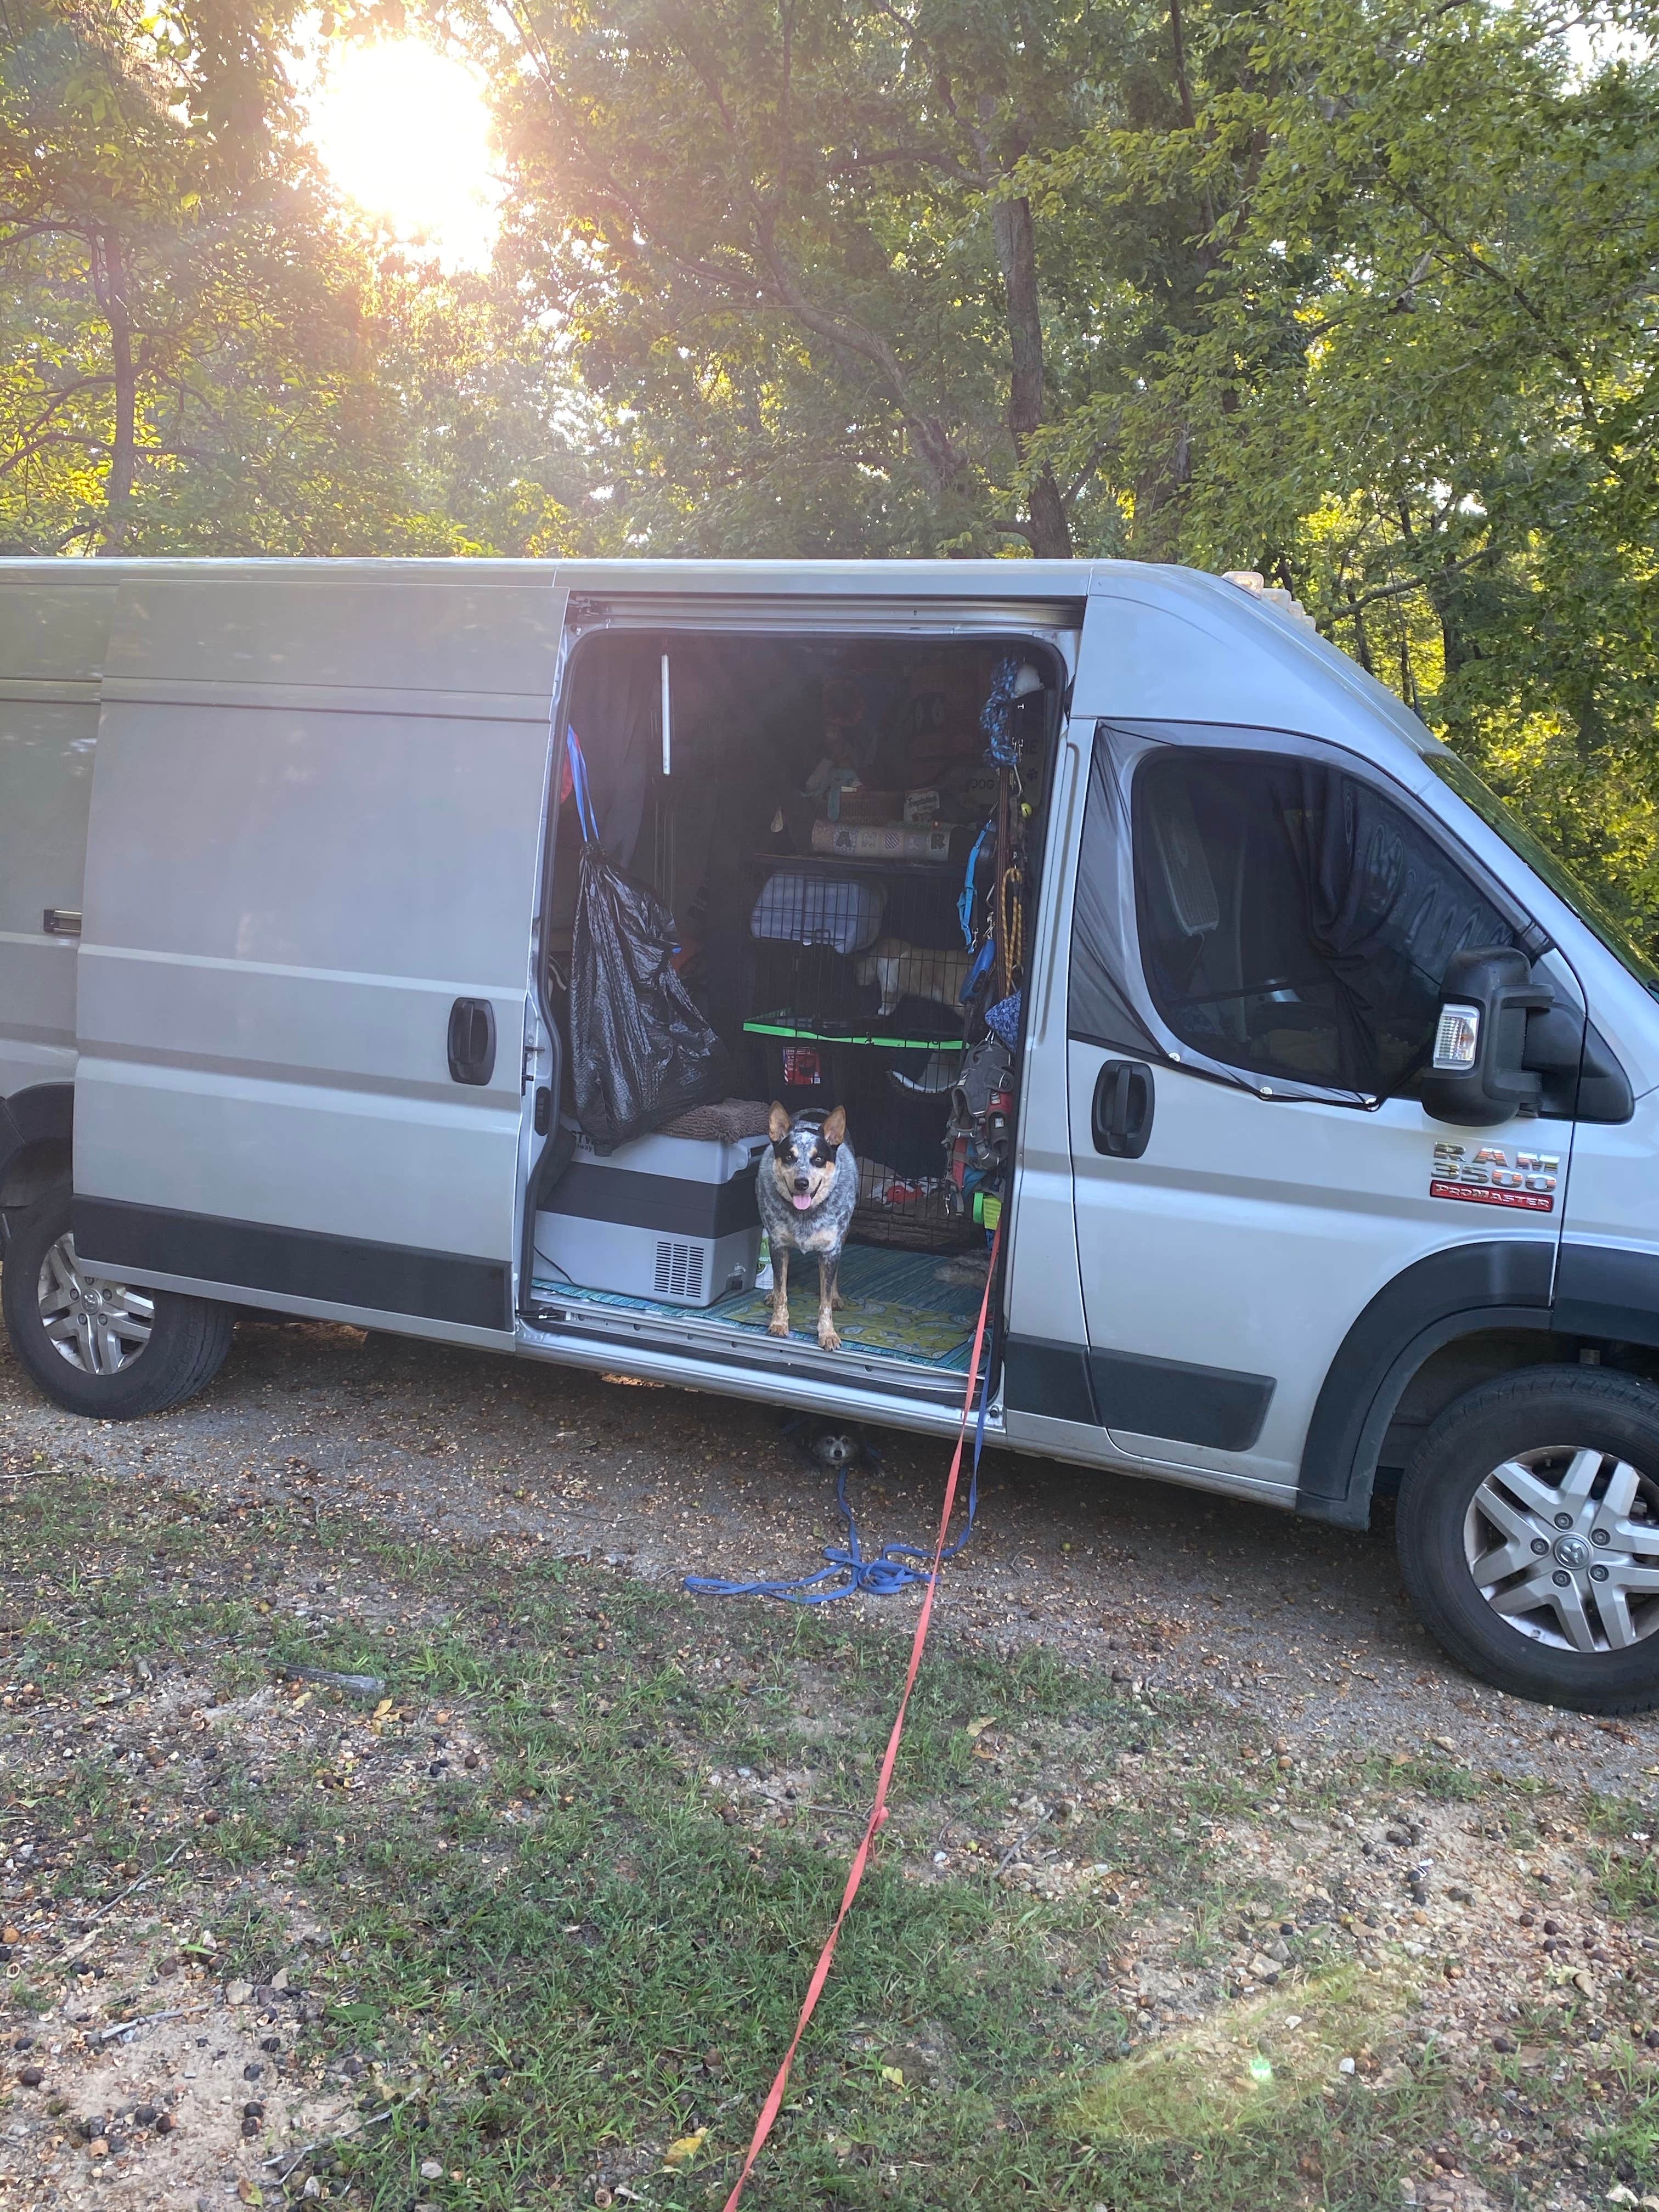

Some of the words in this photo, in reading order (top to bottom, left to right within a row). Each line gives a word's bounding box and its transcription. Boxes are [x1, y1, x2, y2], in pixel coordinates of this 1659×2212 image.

[1433, 1141, 1560, 1174] RAM
[1431, 1160, 1557, 1193] 3500
[1434, 1183, 1550, 1208] PROMASTER
